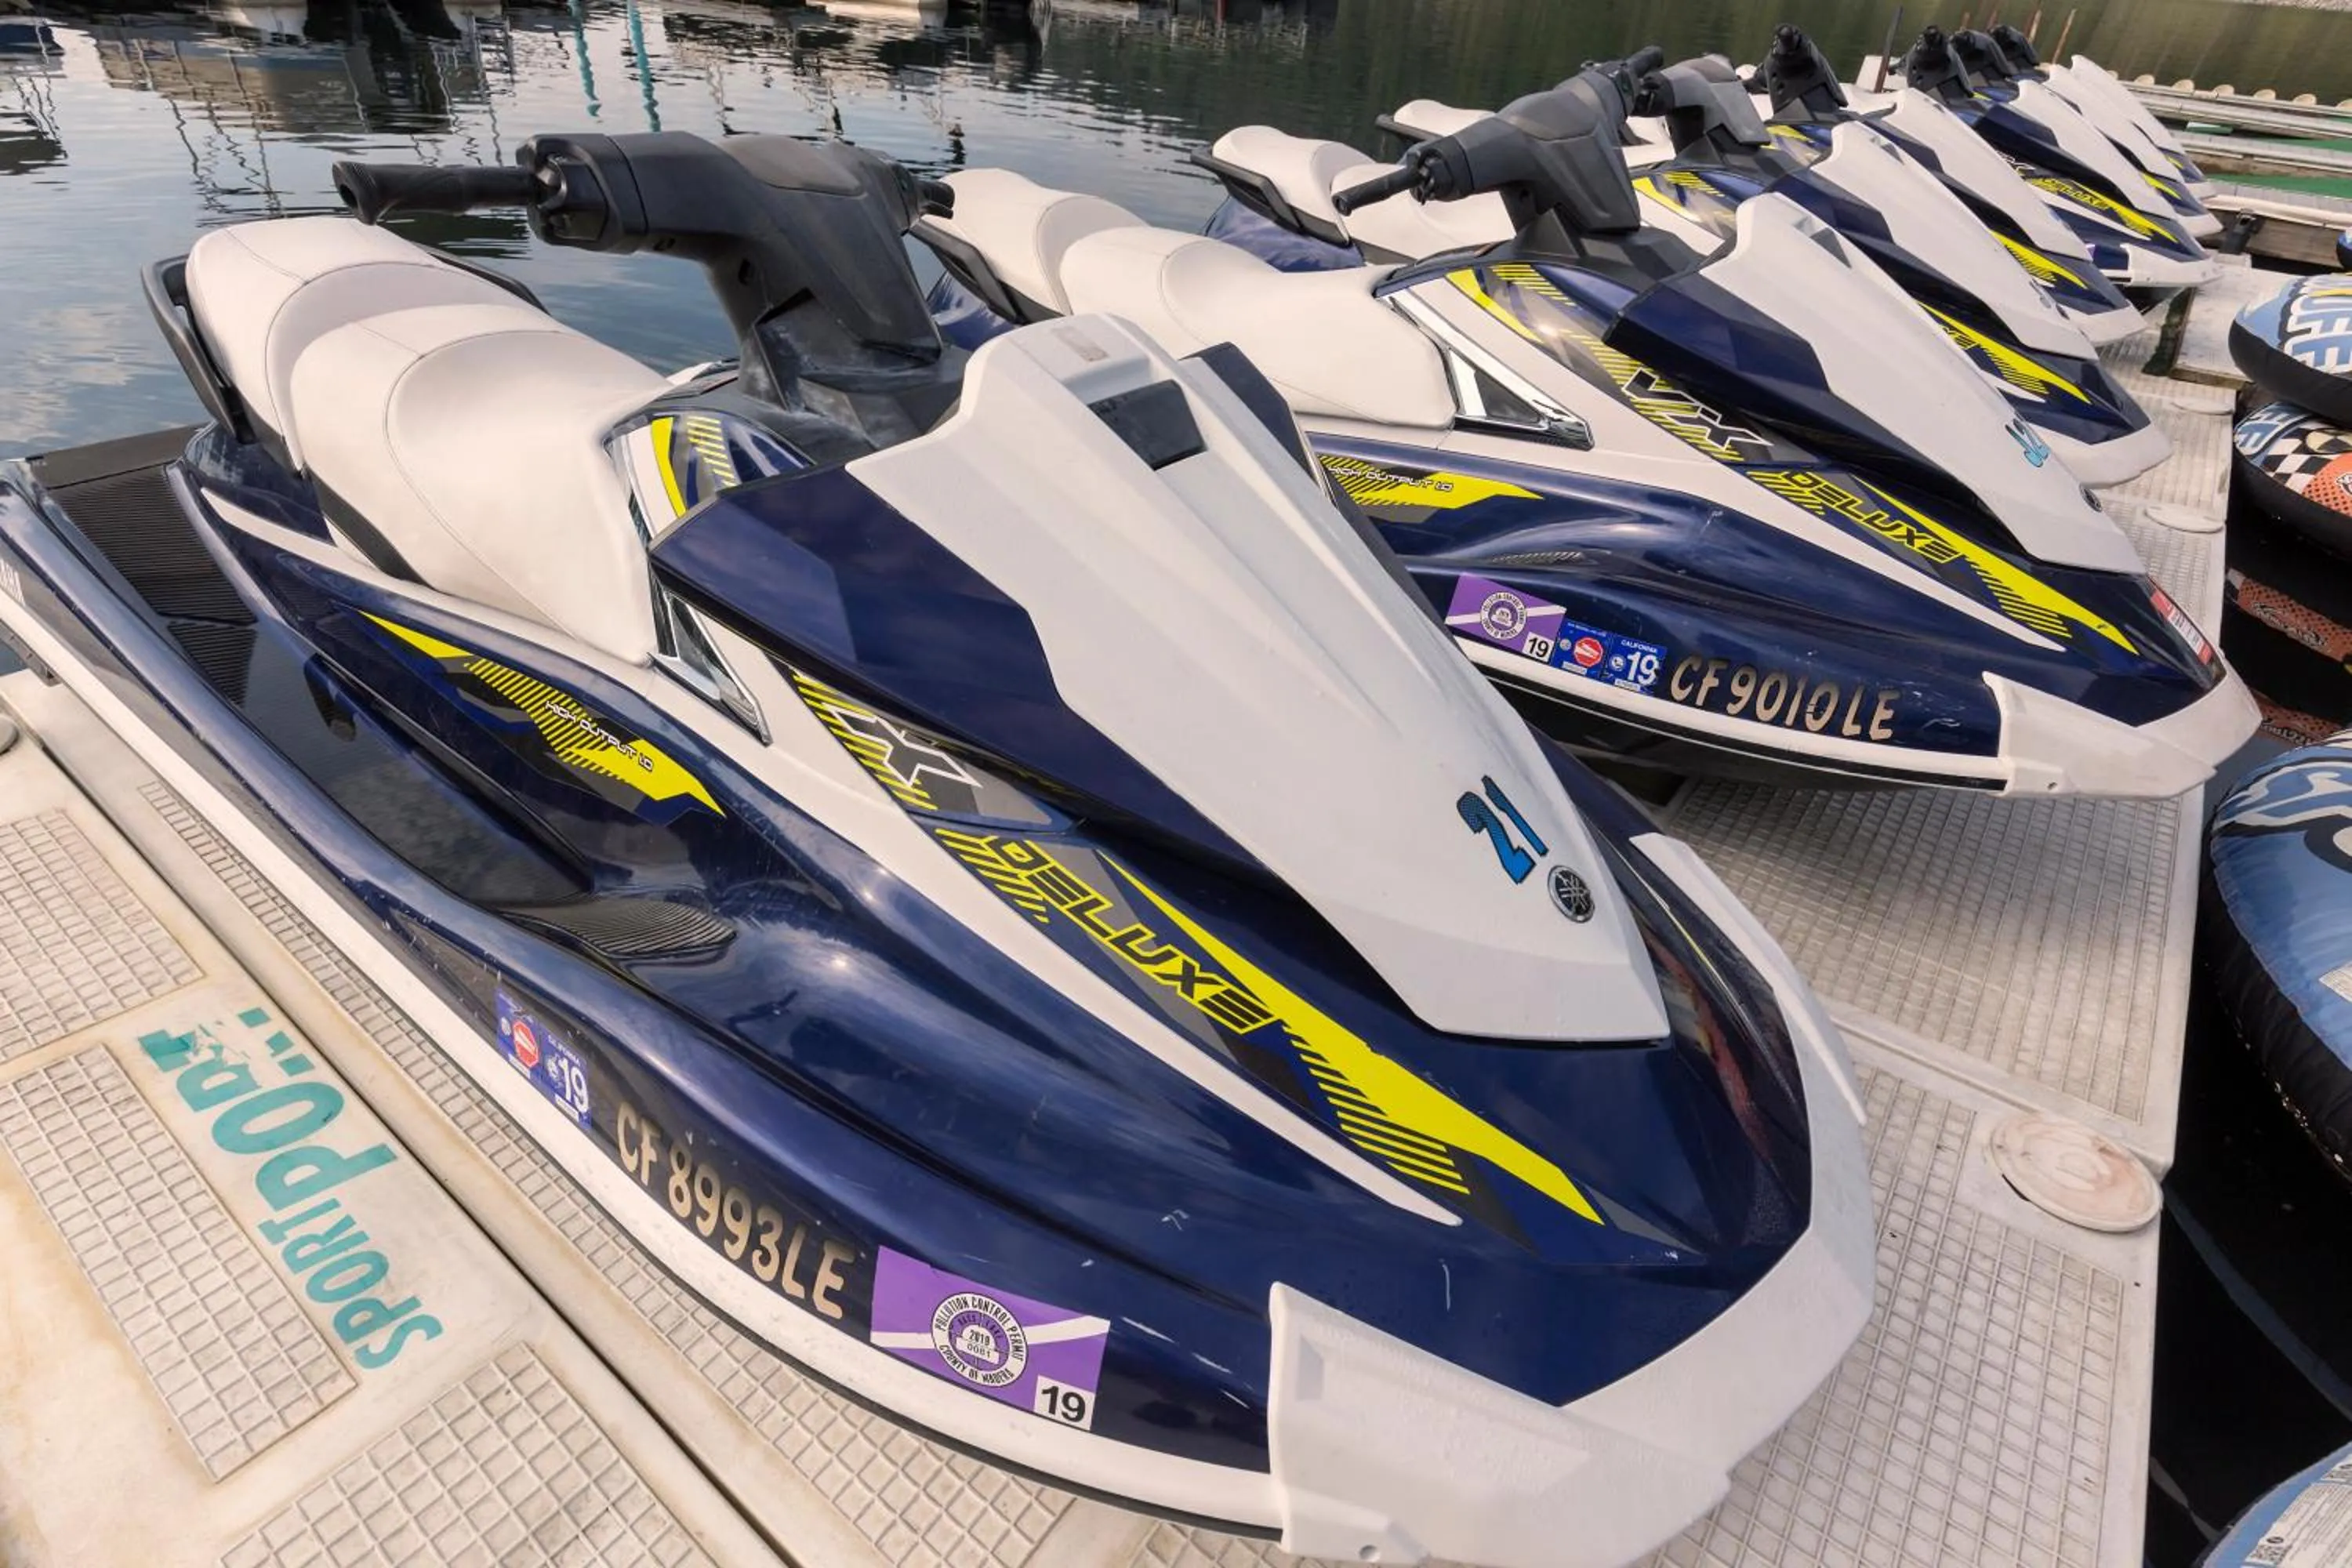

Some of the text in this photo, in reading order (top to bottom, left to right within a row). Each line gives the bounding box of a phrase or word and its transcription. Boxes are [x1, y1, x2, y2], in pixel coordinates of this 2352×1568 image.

[1621, 367, 1775, 451] VX
[1366, 471, 1433, 488] OUTPUT
[1781, 471, 1963, 563] DELUXE
[1529, 637, 1549, 658] 19
[1627, 652, 1660, 686] 19
[1671, 655, 1730, 706] CF
[580, 719, 637, 758] OUTPUT
[1457, 775, 1549, 884] 21
[983, 836, 1279, 1034] DELUXE
[558, 1058, 589, 1113] 19
[617, 1102, 661, 1186] CF
[257, 1197, 445, 1370] SPORT
[971, 1295, 1011, 1327] CONTROL
[1006, 1325, 1024, 1362] PERMIT
[938, 1345, 967, 1373] COUNTY
[968, 1368, 978, 1381] OF
[1041, 1385, 1087, 1423] 19
